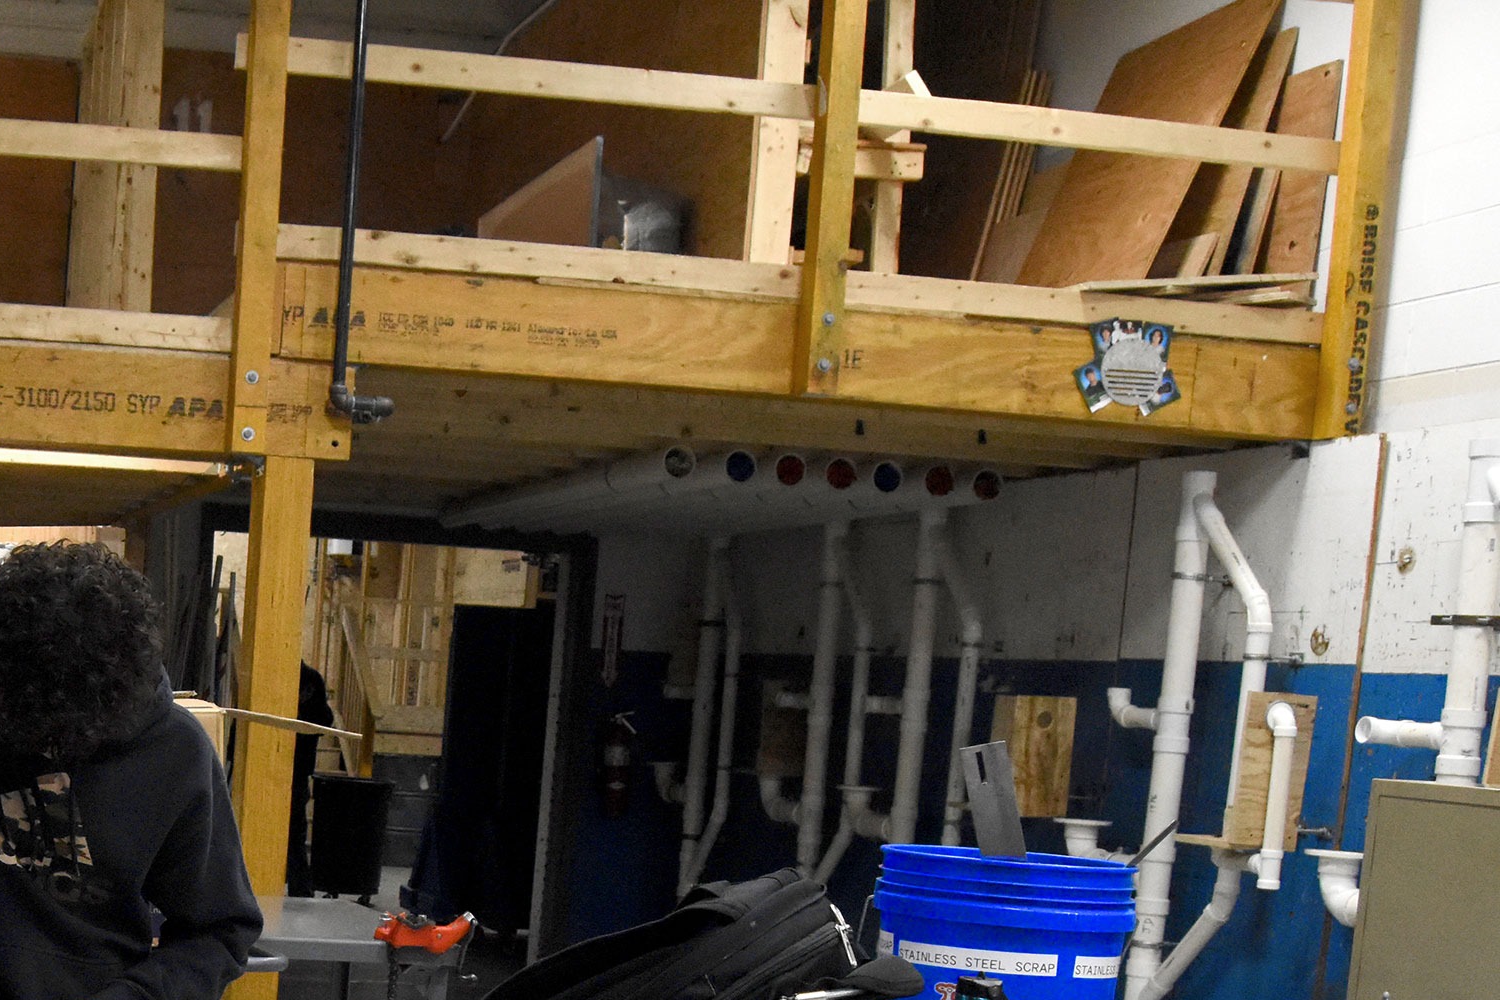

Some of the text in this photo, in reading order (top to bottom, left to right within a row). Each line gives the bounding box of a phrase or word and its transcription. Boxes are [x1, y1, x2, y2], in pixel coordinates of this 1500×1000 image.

[126, 393, 161, 414] SYP
[900, 947, 1056, 973] STAINLESS STEEL SCRAP
